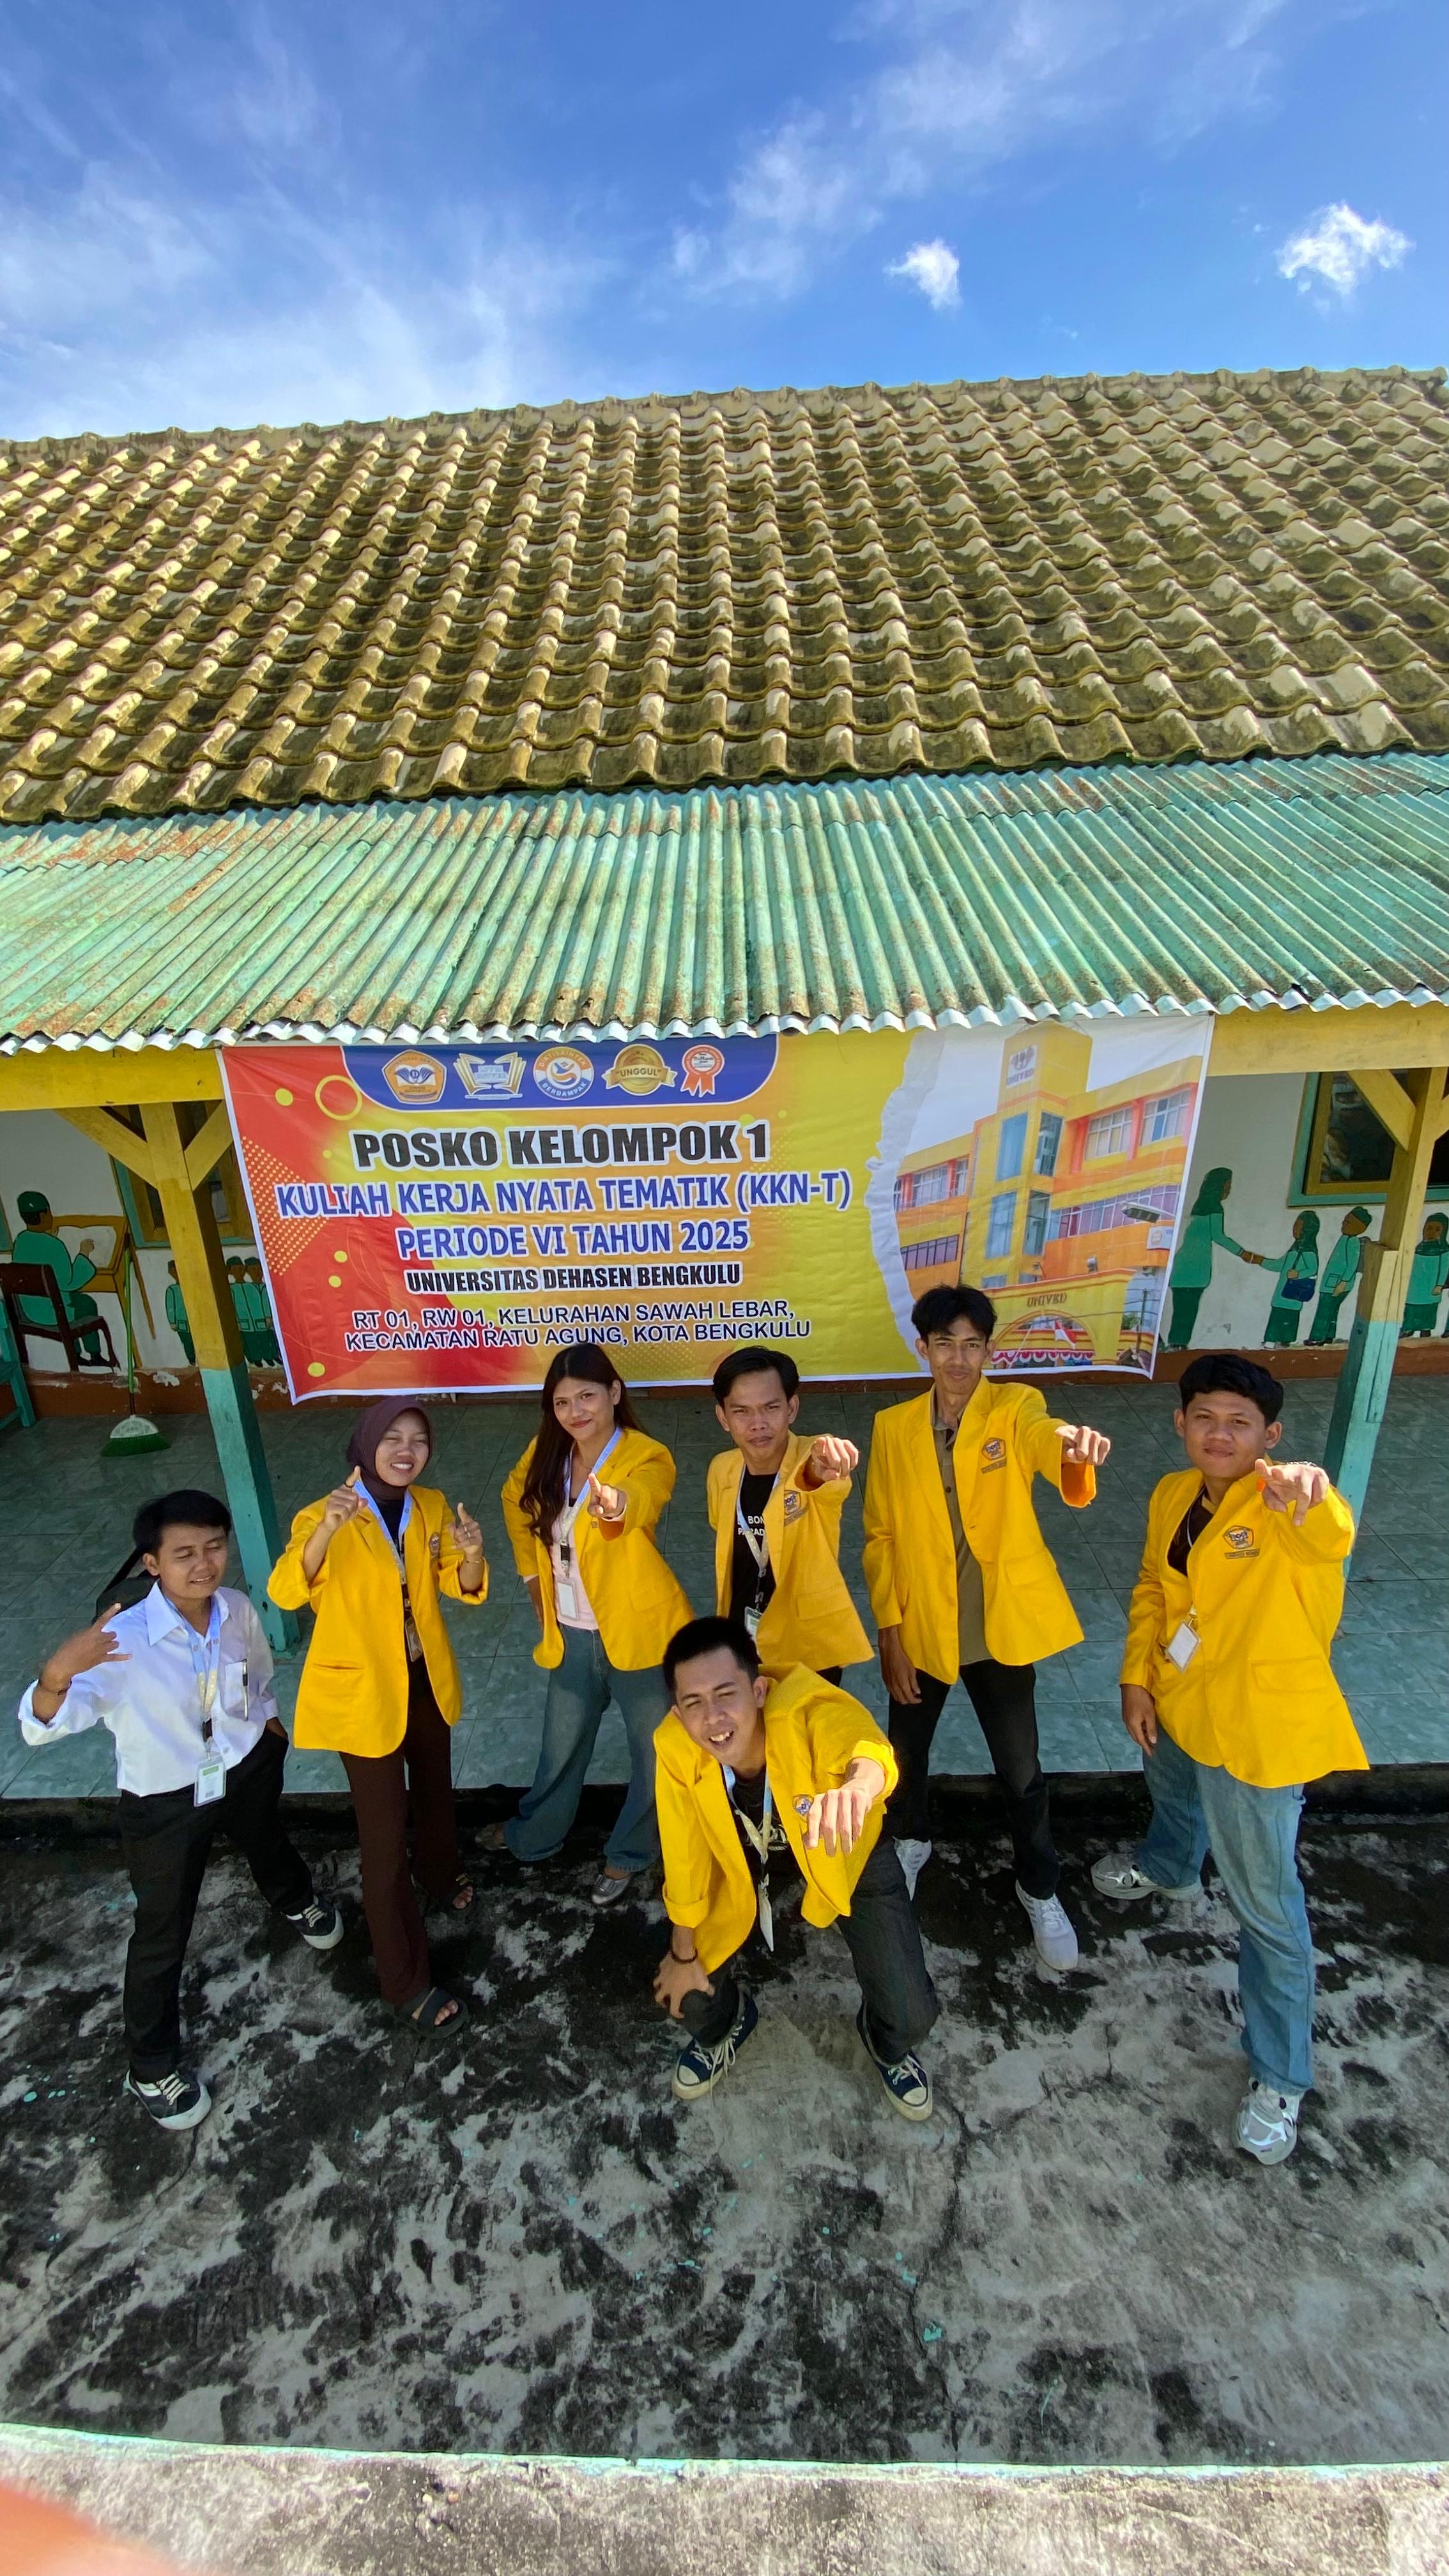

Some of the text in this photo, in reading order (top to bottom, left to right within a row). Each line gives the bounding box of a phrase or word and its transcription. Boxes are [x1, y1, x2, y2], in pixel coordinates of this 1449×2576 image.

[542, 1081, 587, 1096] BERDAMPAK
[353, 1123, 767, 1167] POSKO KELOMPOK 1
[277, 1171, 850, 1216] KULIAH KERJA NYATA TEMATIK (KKN-T)
[398, 1221, 749, 1258] PERIODE VI TAHUN 2025
[406, 1264, 741, 1292] UNIVERSITAS DEHASEN BENGKULU
[353, 1300, 794, 1329] RT 01, RW 01, KELURAHAN SAWAH LEBAR,
[346, 1321, 810, 1350] KECAMATAN RATU AGUNG, KOTA BENGKULU
